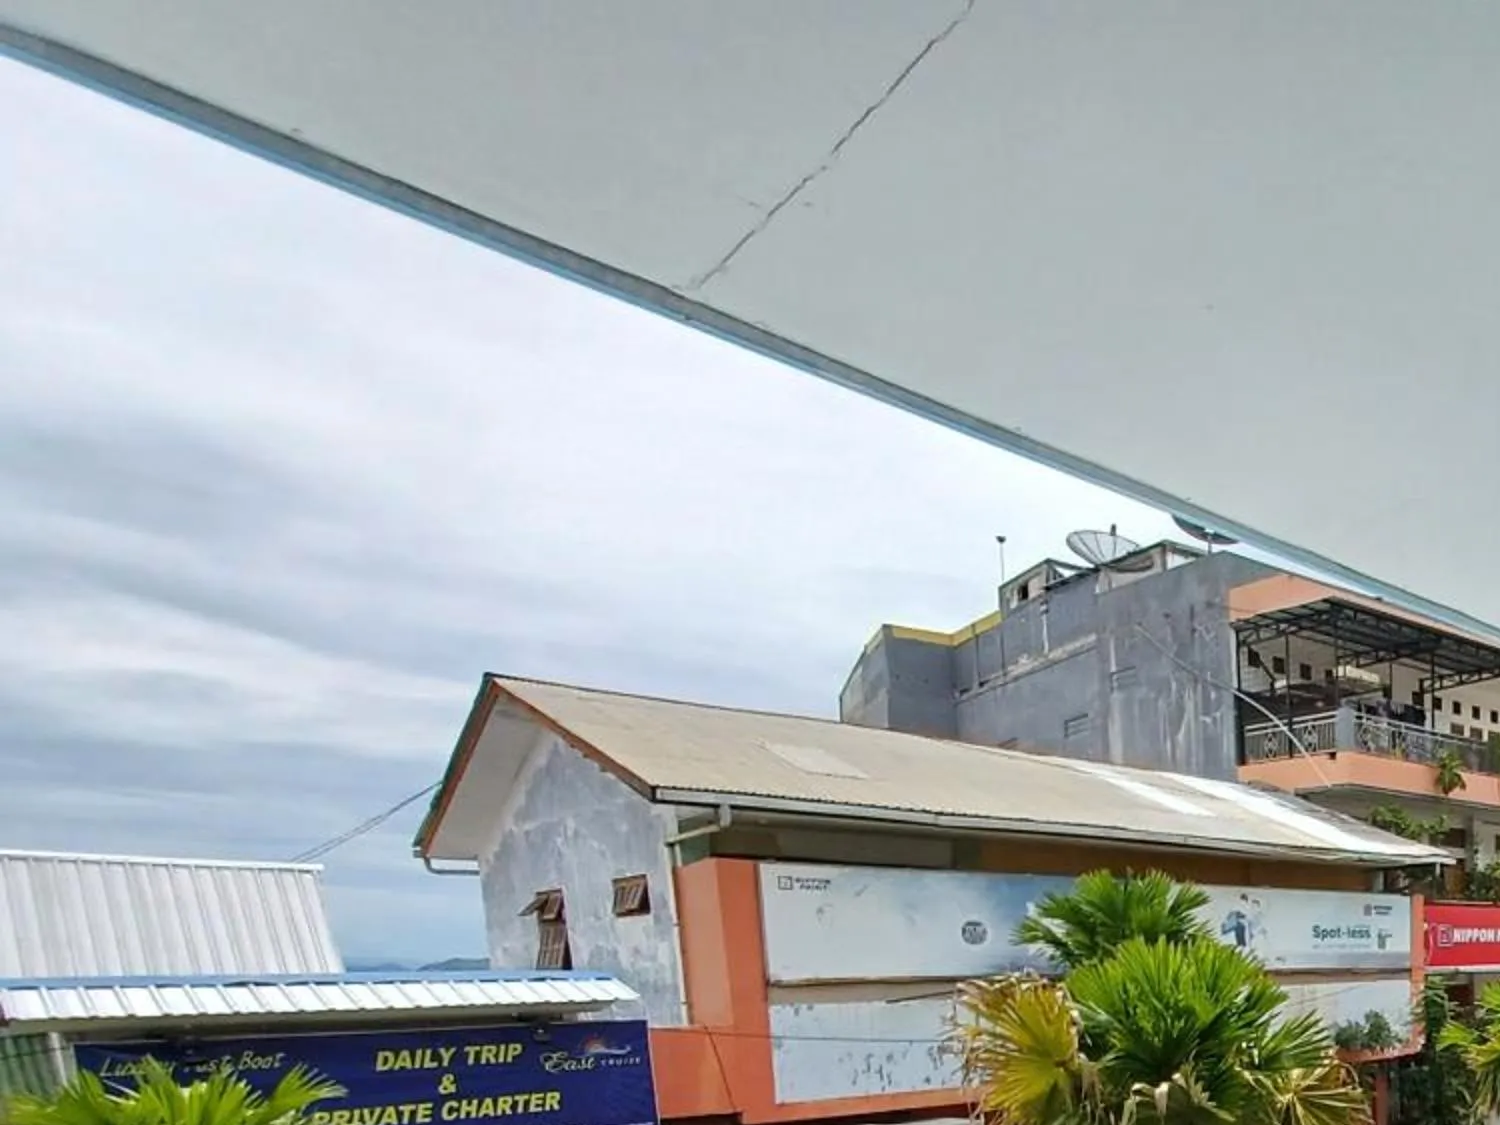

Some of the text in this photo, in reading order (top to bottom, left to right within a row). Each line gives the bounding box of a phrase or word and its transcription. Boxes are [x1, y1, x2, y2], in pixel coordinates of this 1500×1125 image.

[1312, 924, 1371, 942] Spot-less
[1452, 927, 1496, 943] NIPPON
[238, 1050, 286, 1070] Boat
[375, 1042, 523, 1072] DAILY TRIP
[540, 1051, 597, 1075] East
[438, 1073, 458, 1095] &
[441, 1091, 562, 1121] CHARTER
